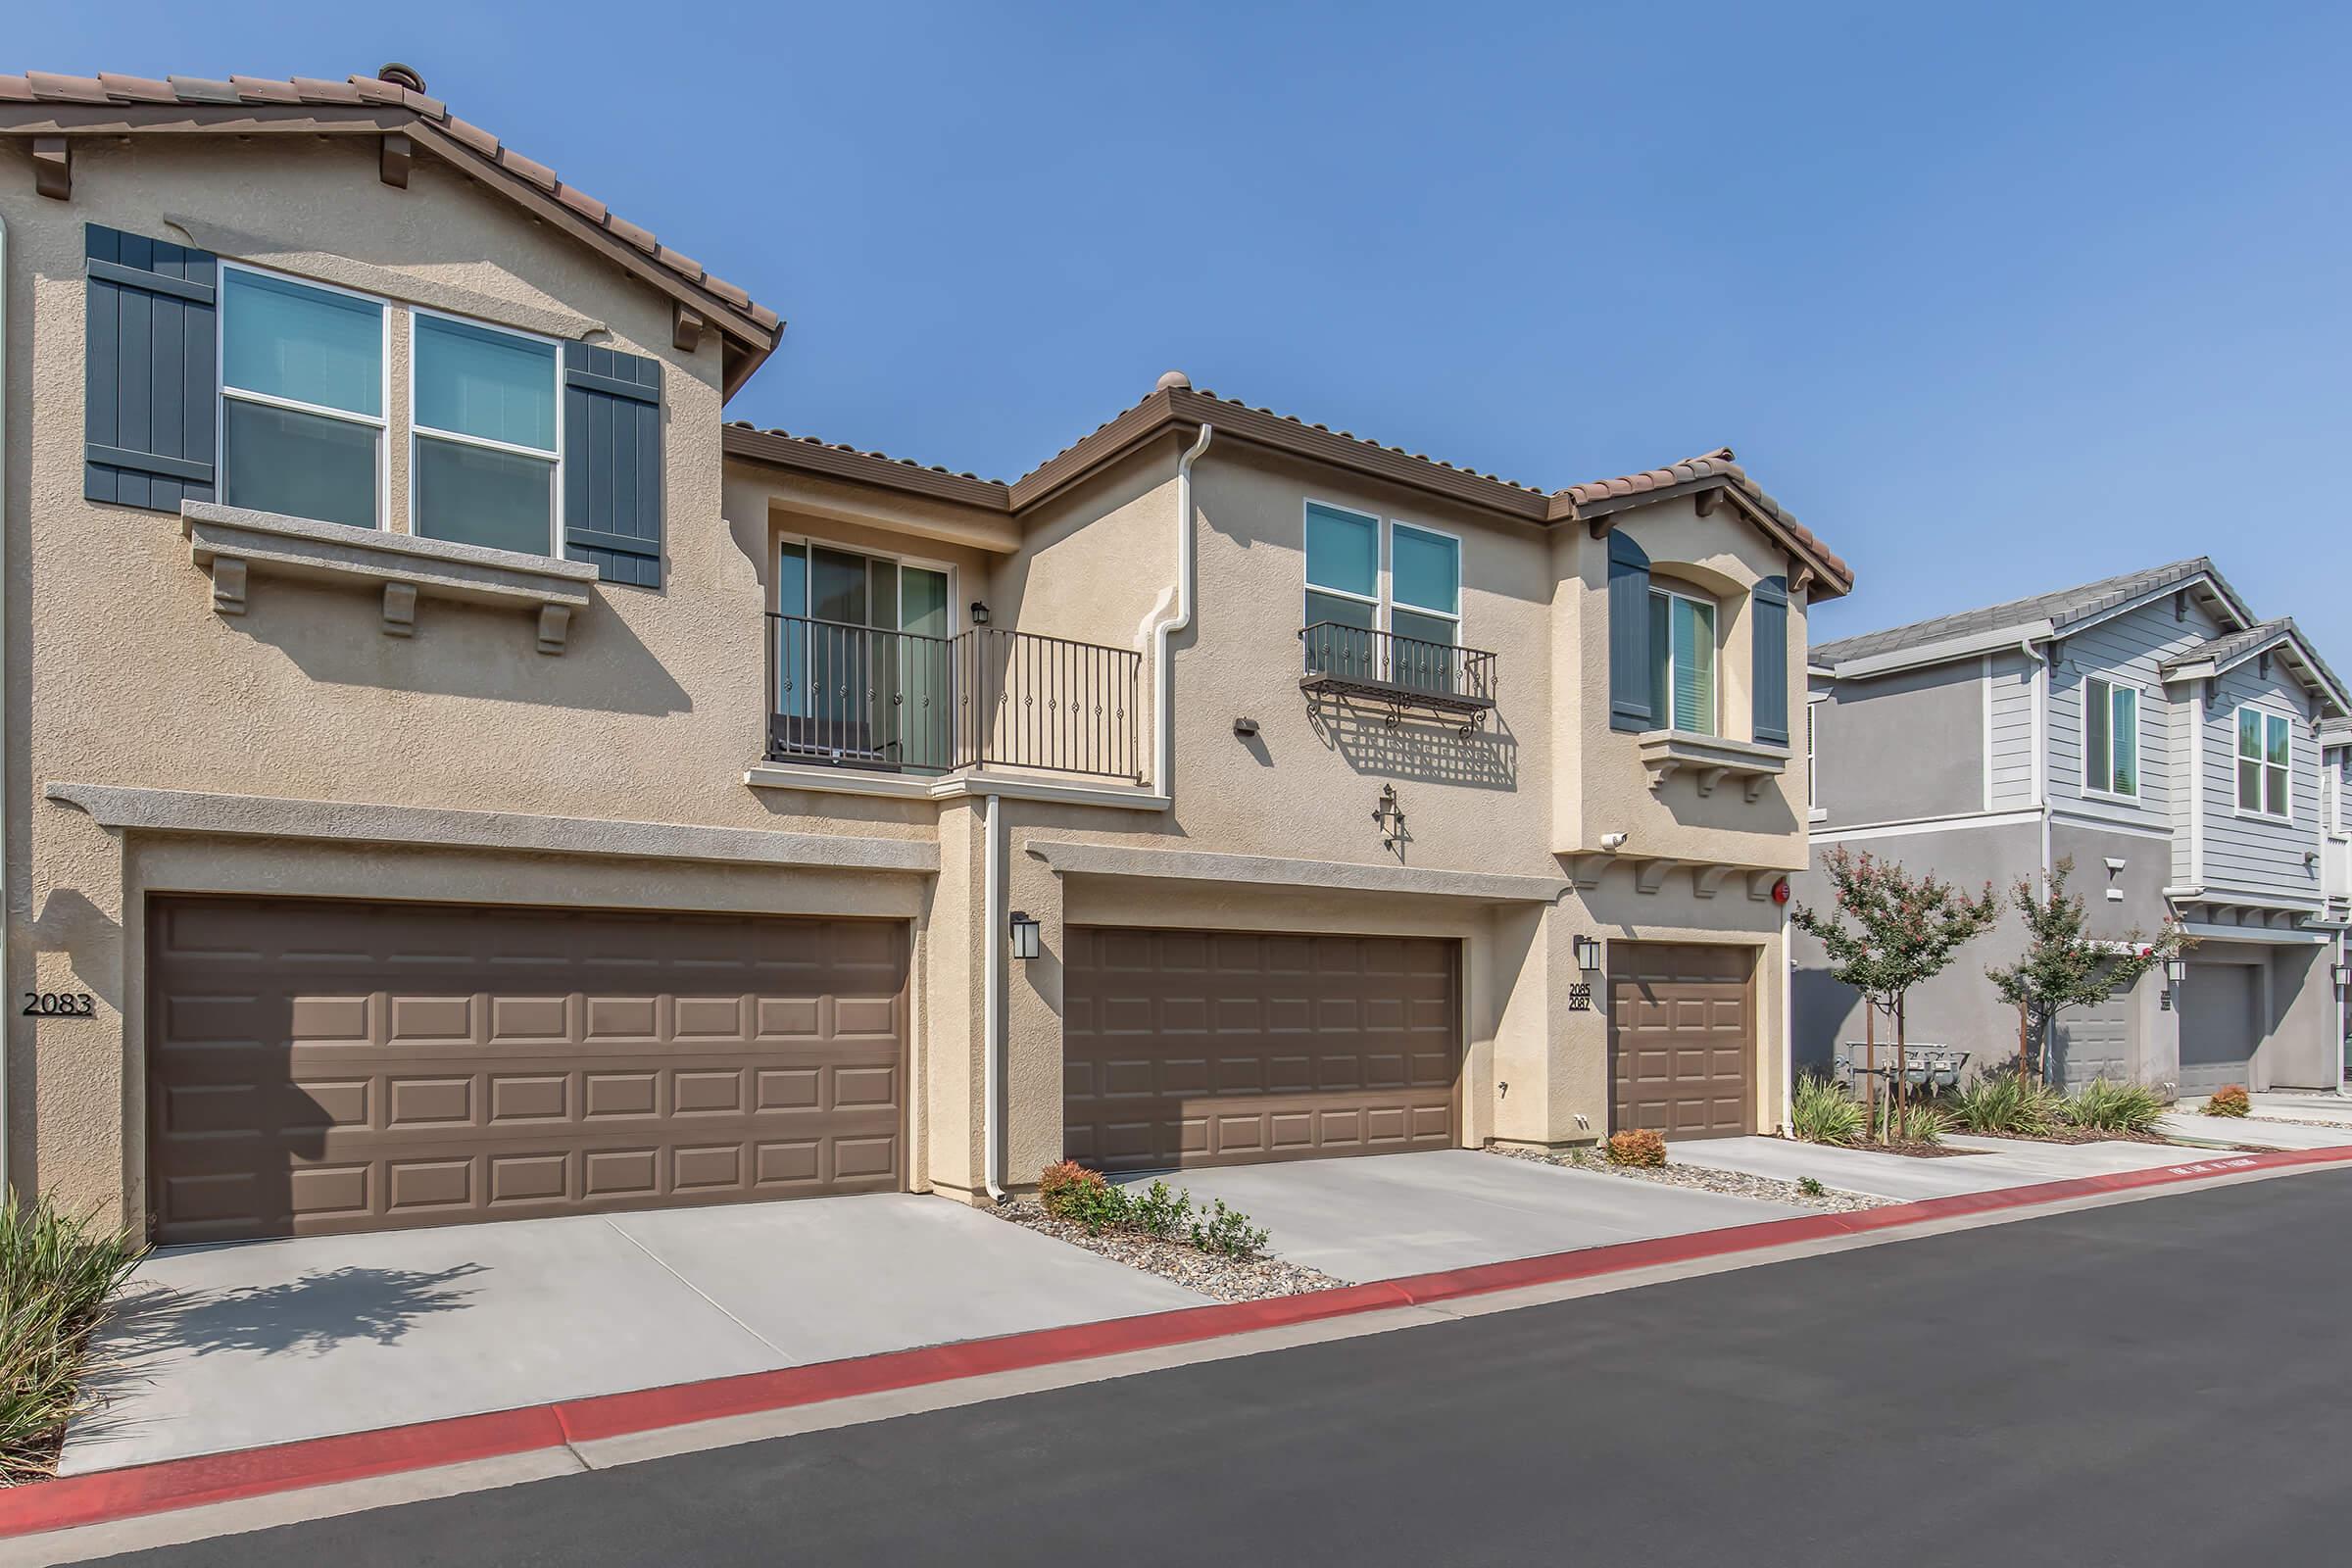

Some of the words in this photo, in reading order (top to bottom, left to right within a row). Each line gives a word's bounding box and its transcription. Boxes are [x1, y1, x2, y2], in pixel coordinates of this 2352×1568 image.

[1569, 983, 1591, 997] 2085
[24, 993, 92, 1016] 2083
[1568, 997, 1591, 1011] 2087
